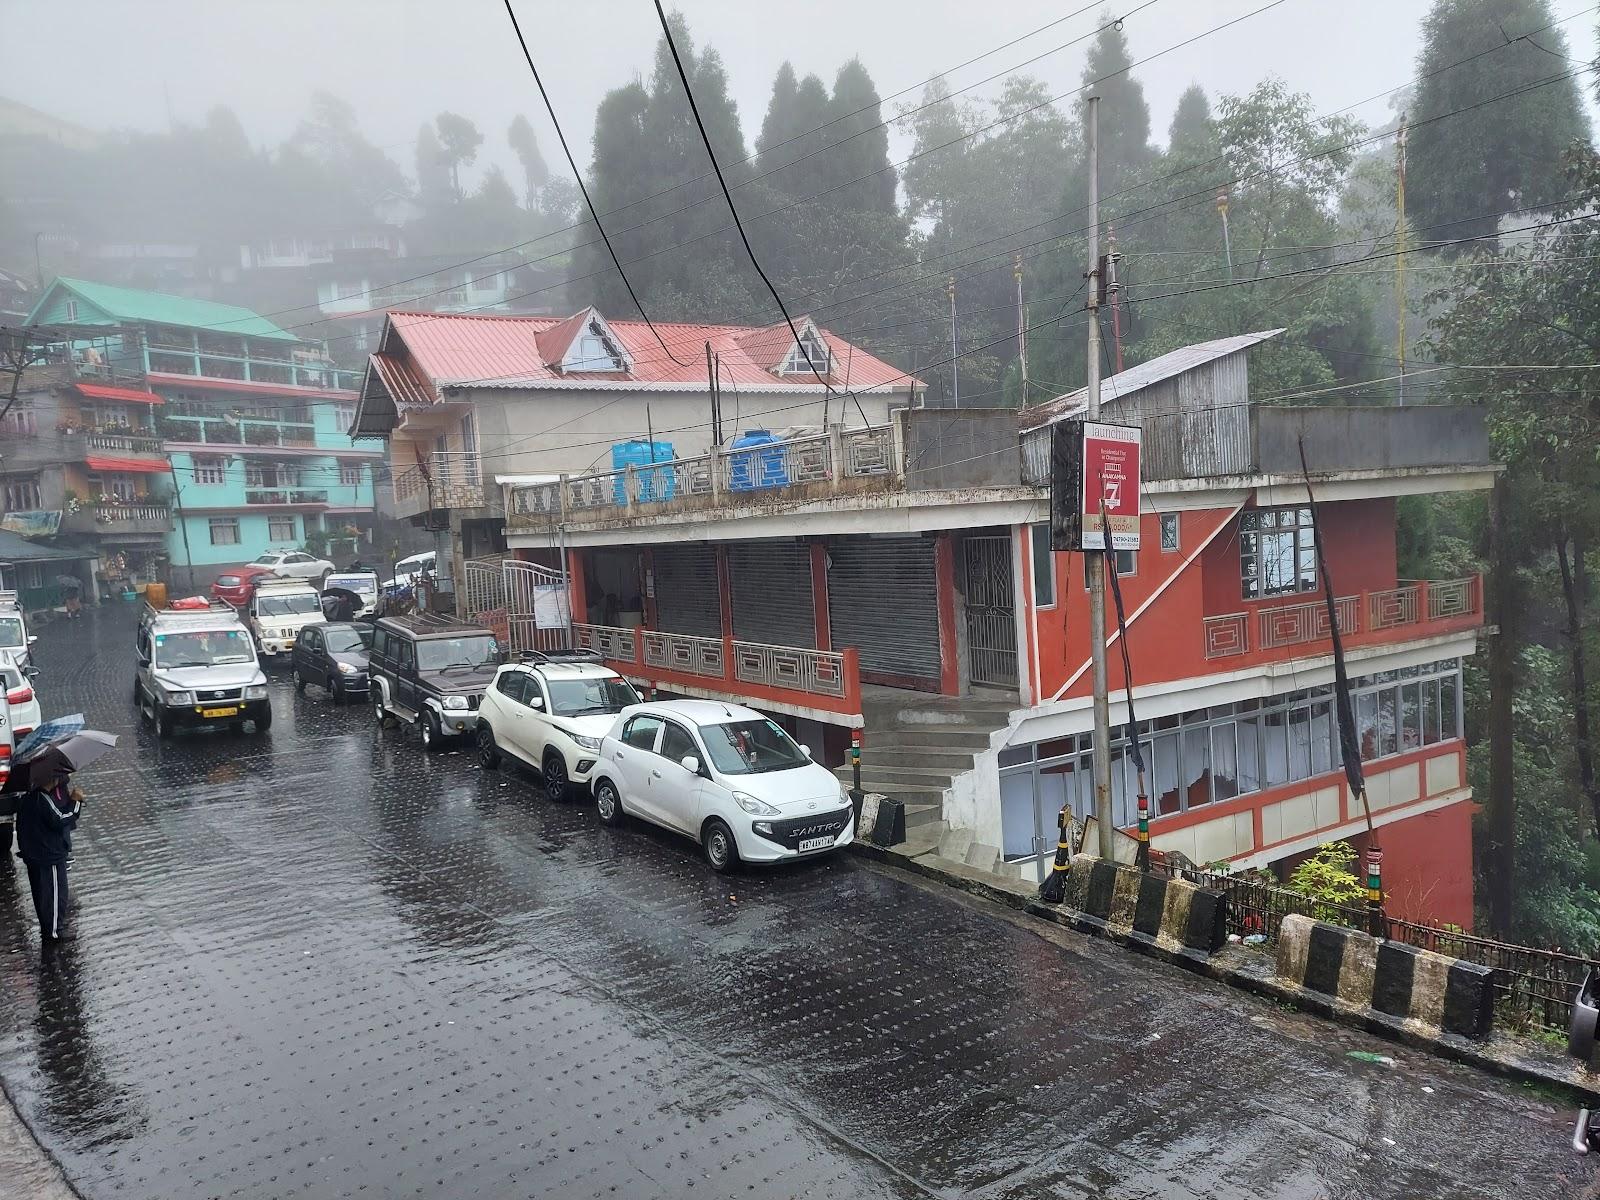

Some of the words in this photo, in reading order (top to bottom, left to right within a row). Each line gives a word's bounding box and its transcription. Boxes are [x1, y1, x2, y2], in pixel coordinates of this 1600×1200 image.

[1092, 425, 1135, 442] launching
[1105, 482, 1120, 500] 7
[789, 822, 841, 838] SANTRO
